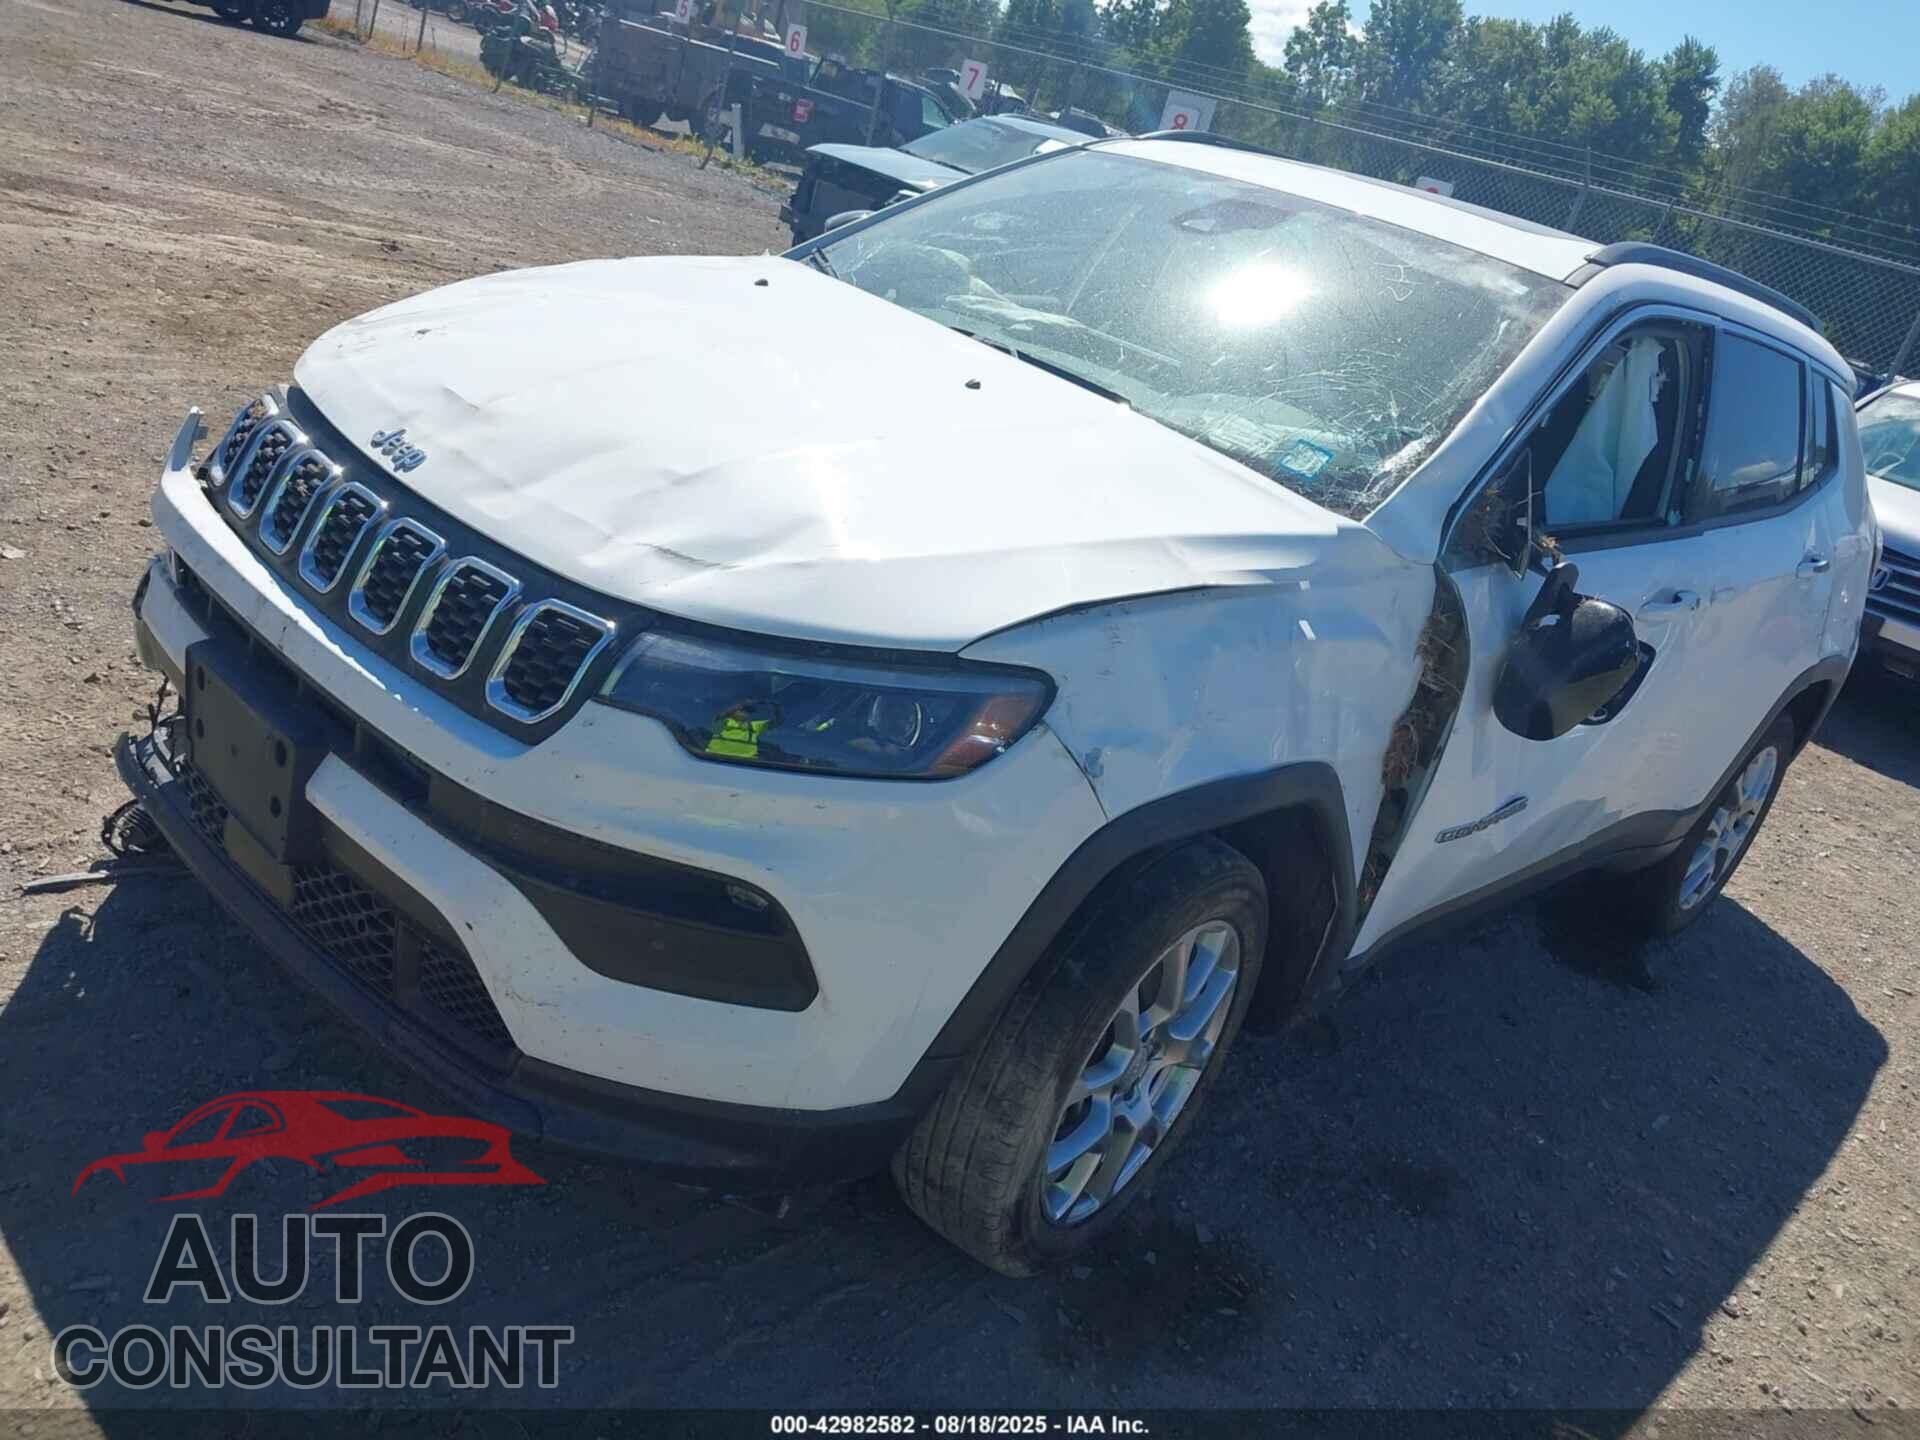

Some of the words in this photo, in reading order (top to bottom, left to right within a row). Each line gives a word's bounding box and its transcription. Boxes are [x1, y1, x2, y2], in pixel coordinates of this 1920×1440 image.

[790, 31, 801, 52] 6
[968, 67, 979, 91] 7
[370, 428, 427, 473] Jeep
